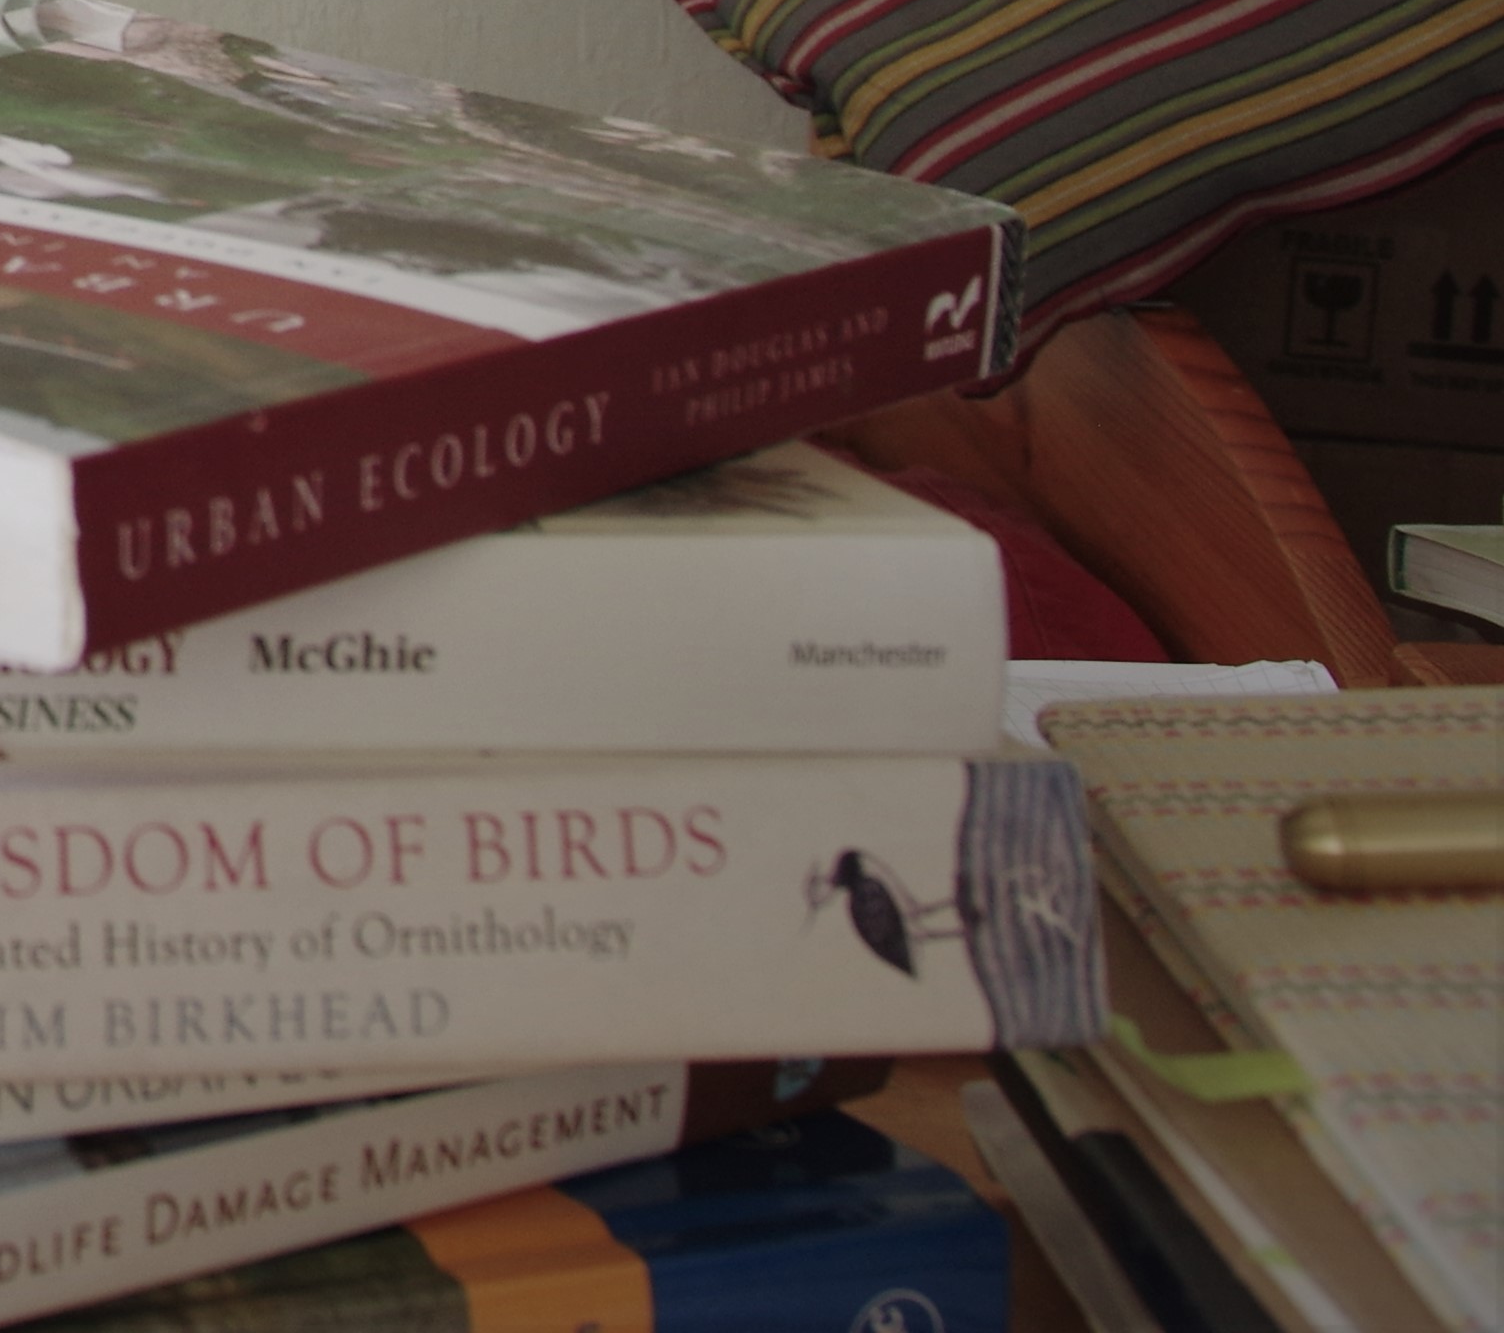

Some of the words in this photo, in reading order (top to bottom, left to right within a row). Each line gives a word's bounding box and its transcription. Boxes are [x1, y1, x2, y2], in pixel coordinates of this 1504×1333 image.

[118, 469, 324, 582] URBAN
[359, 390, 610, 513] ECOLOGY
[249, 632, 437, 676] McGhie
[790, 638, 948, 670] Manchester
[308, 813, 427, 891] OF
[462, 803, 729, 885] BIRDS
[102, 918, 273, 973] History
[289, 910, 342, 962] of
[350, 902, 635, 962] Ornithology
[103, 987, 452, 1050] BIRKHEAD
